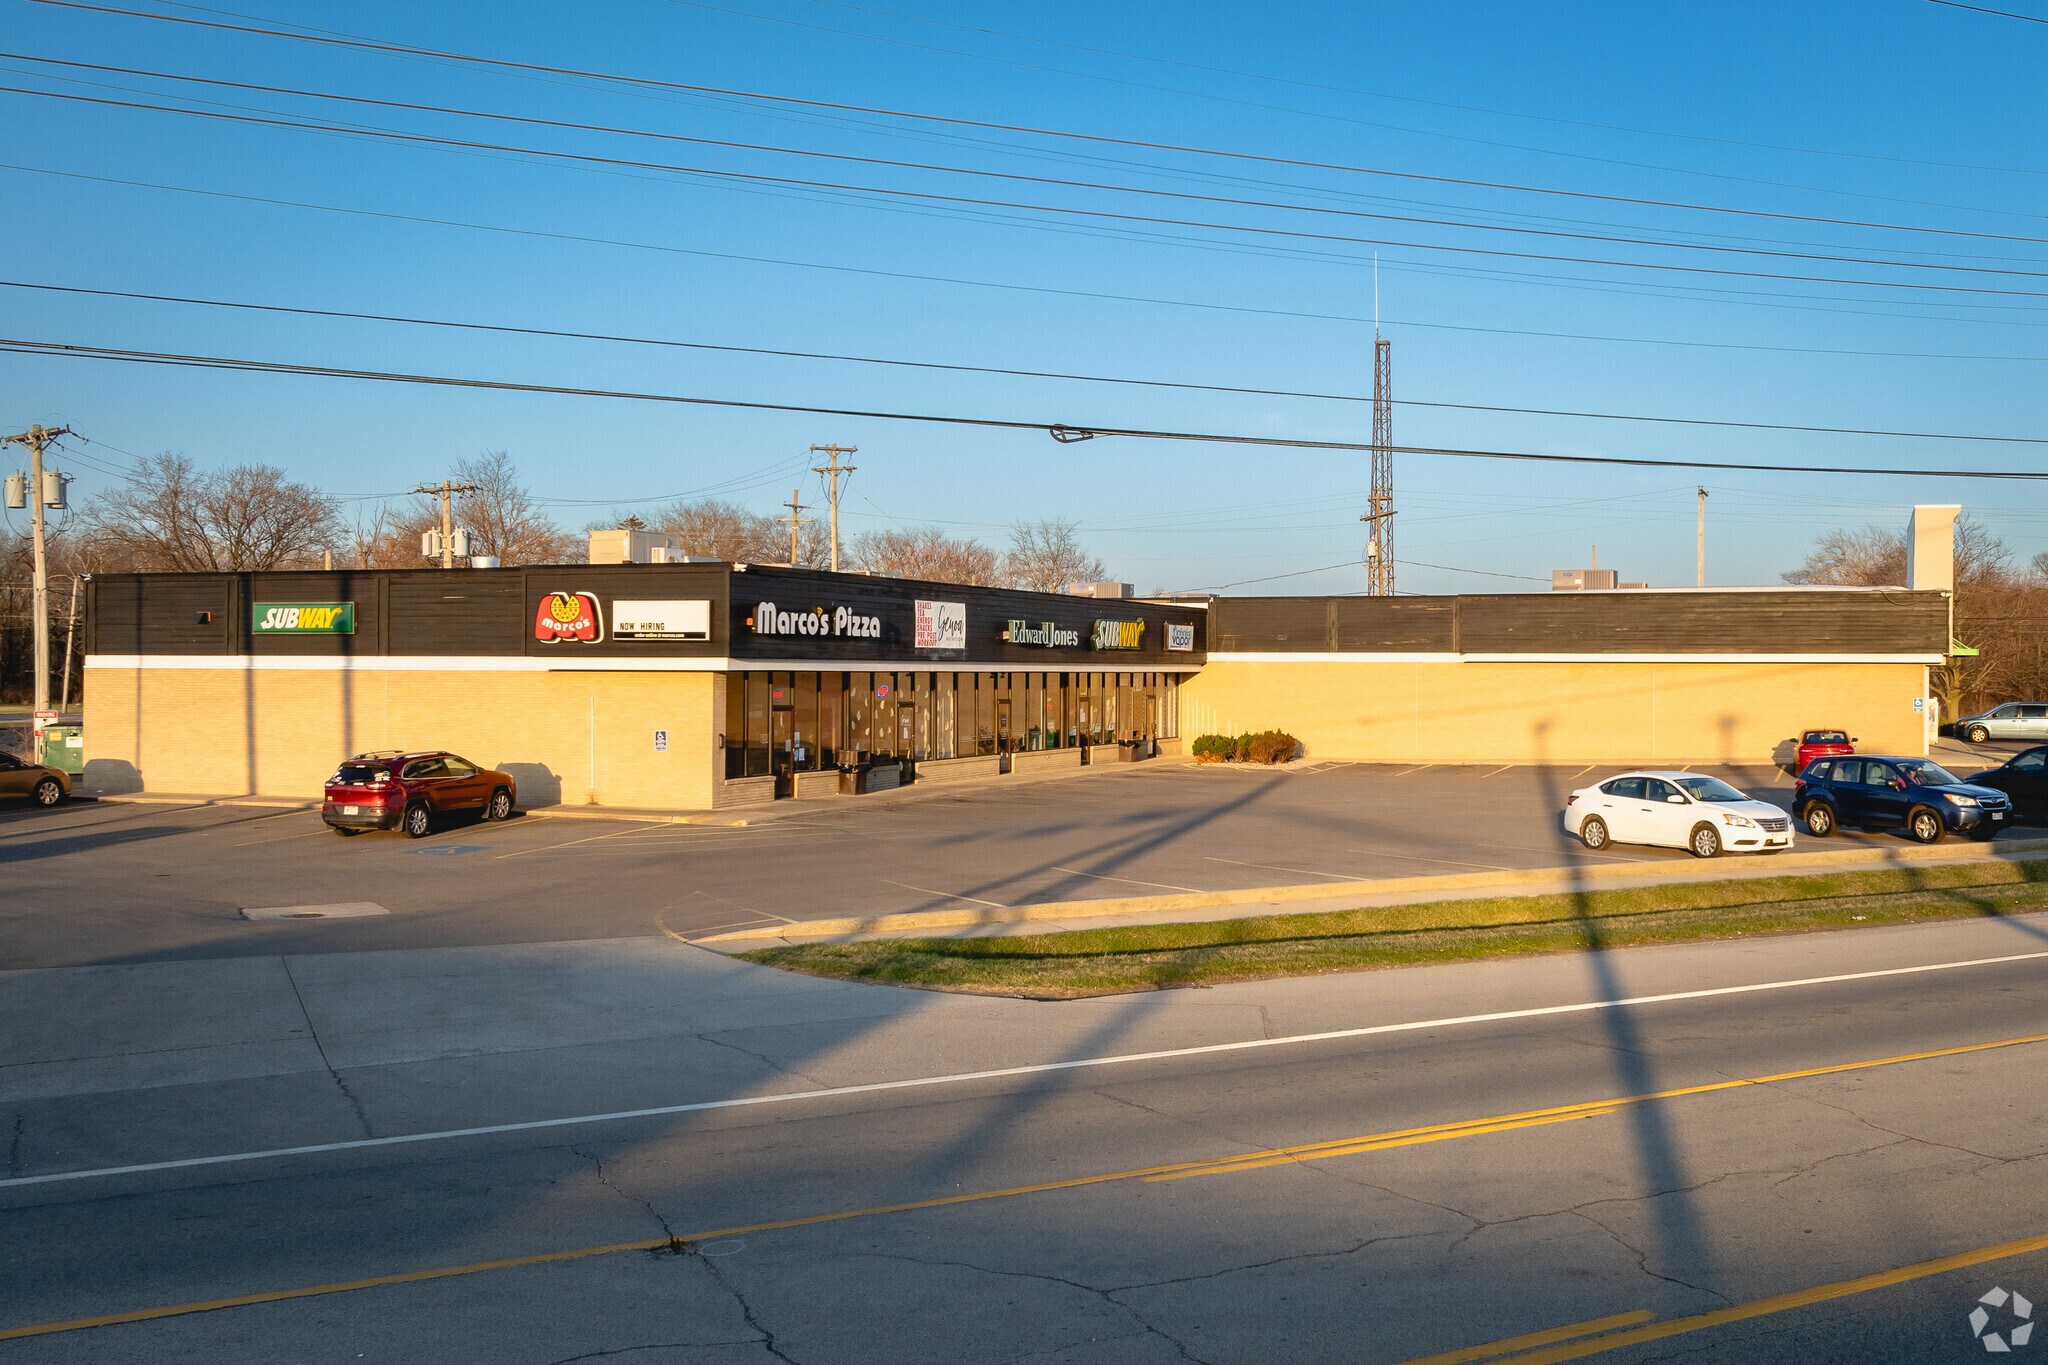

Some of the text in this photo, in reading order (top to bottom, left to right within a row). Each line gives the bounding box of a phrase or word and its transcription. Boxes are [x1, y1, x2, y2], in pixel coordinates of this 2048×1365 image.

[260, 606, 343, 630] SUBWAY
[541, 617, 590, 631] marco's
[619, 622, 665, 631] NOW HIRING
[757, 601, 880, 637] Marco's Pizza
[917, 616, 932, 624] ENERGY
[1094, 618, 1146, 649] SUBWAY
